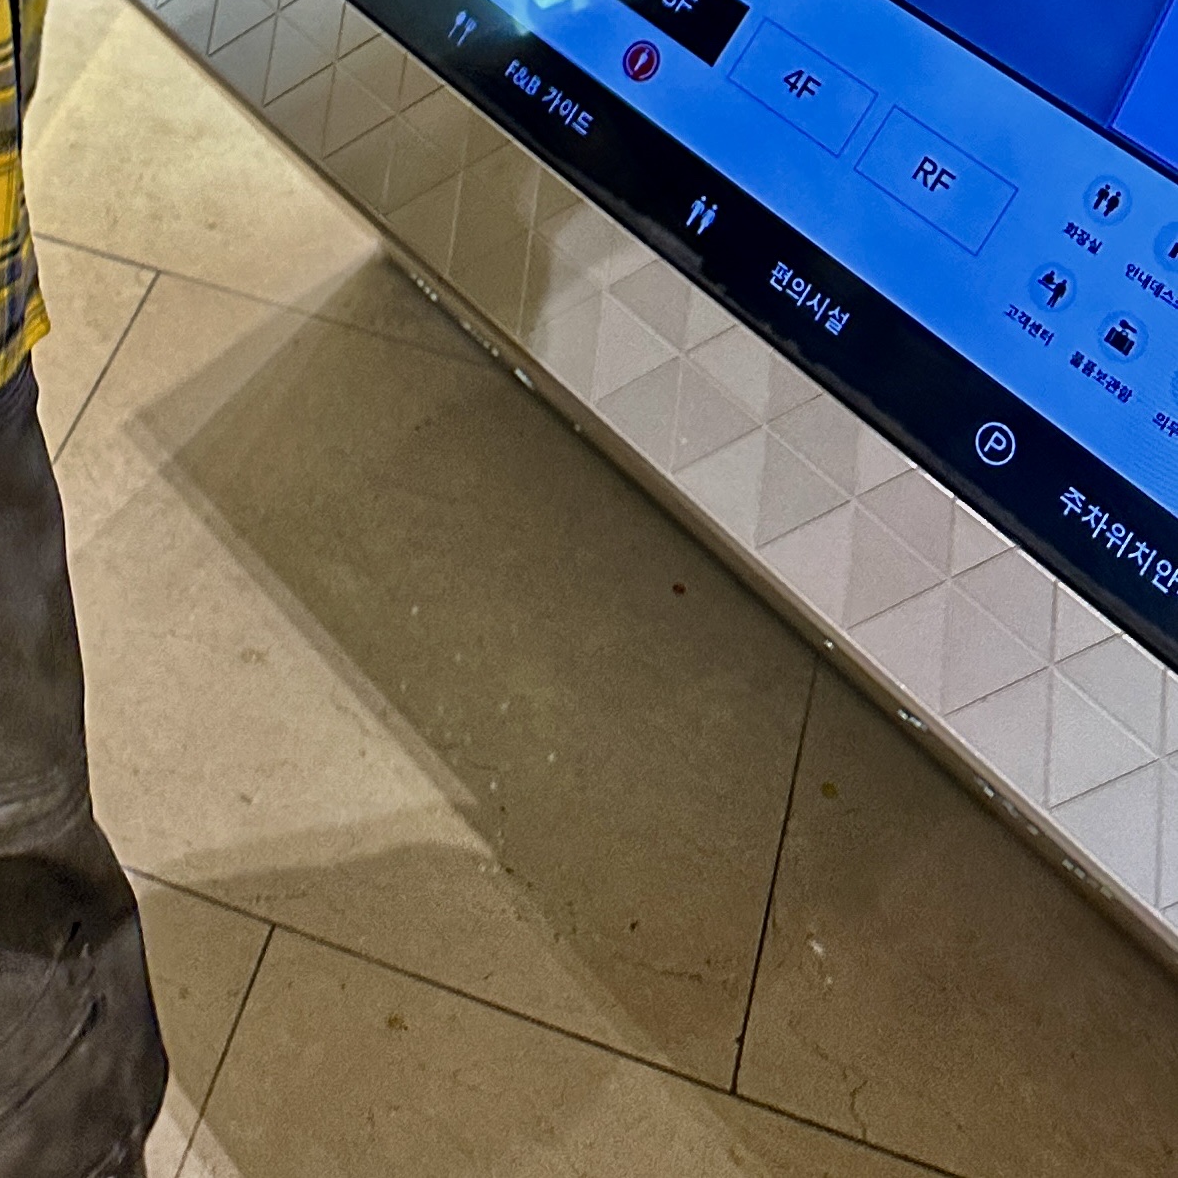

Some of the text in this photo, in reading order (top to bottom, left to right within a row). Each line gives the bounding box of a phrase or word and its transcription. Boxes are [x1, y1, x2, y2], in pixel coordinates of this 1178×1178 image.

[503, 58, 595, 137] F&B 가이드
[783, 68, 822, 100] 4F
[911, 155, 957, 194] RF
[1063, 221, 1105, 256] 화장실
[768, 260, 851, 337] 편의시설
[1002, 303, 1057, 348] 고객센터
[1069, 350, 1133, 403] 물품보관함
[1059, 486, 1178, 595] 주차위치안
